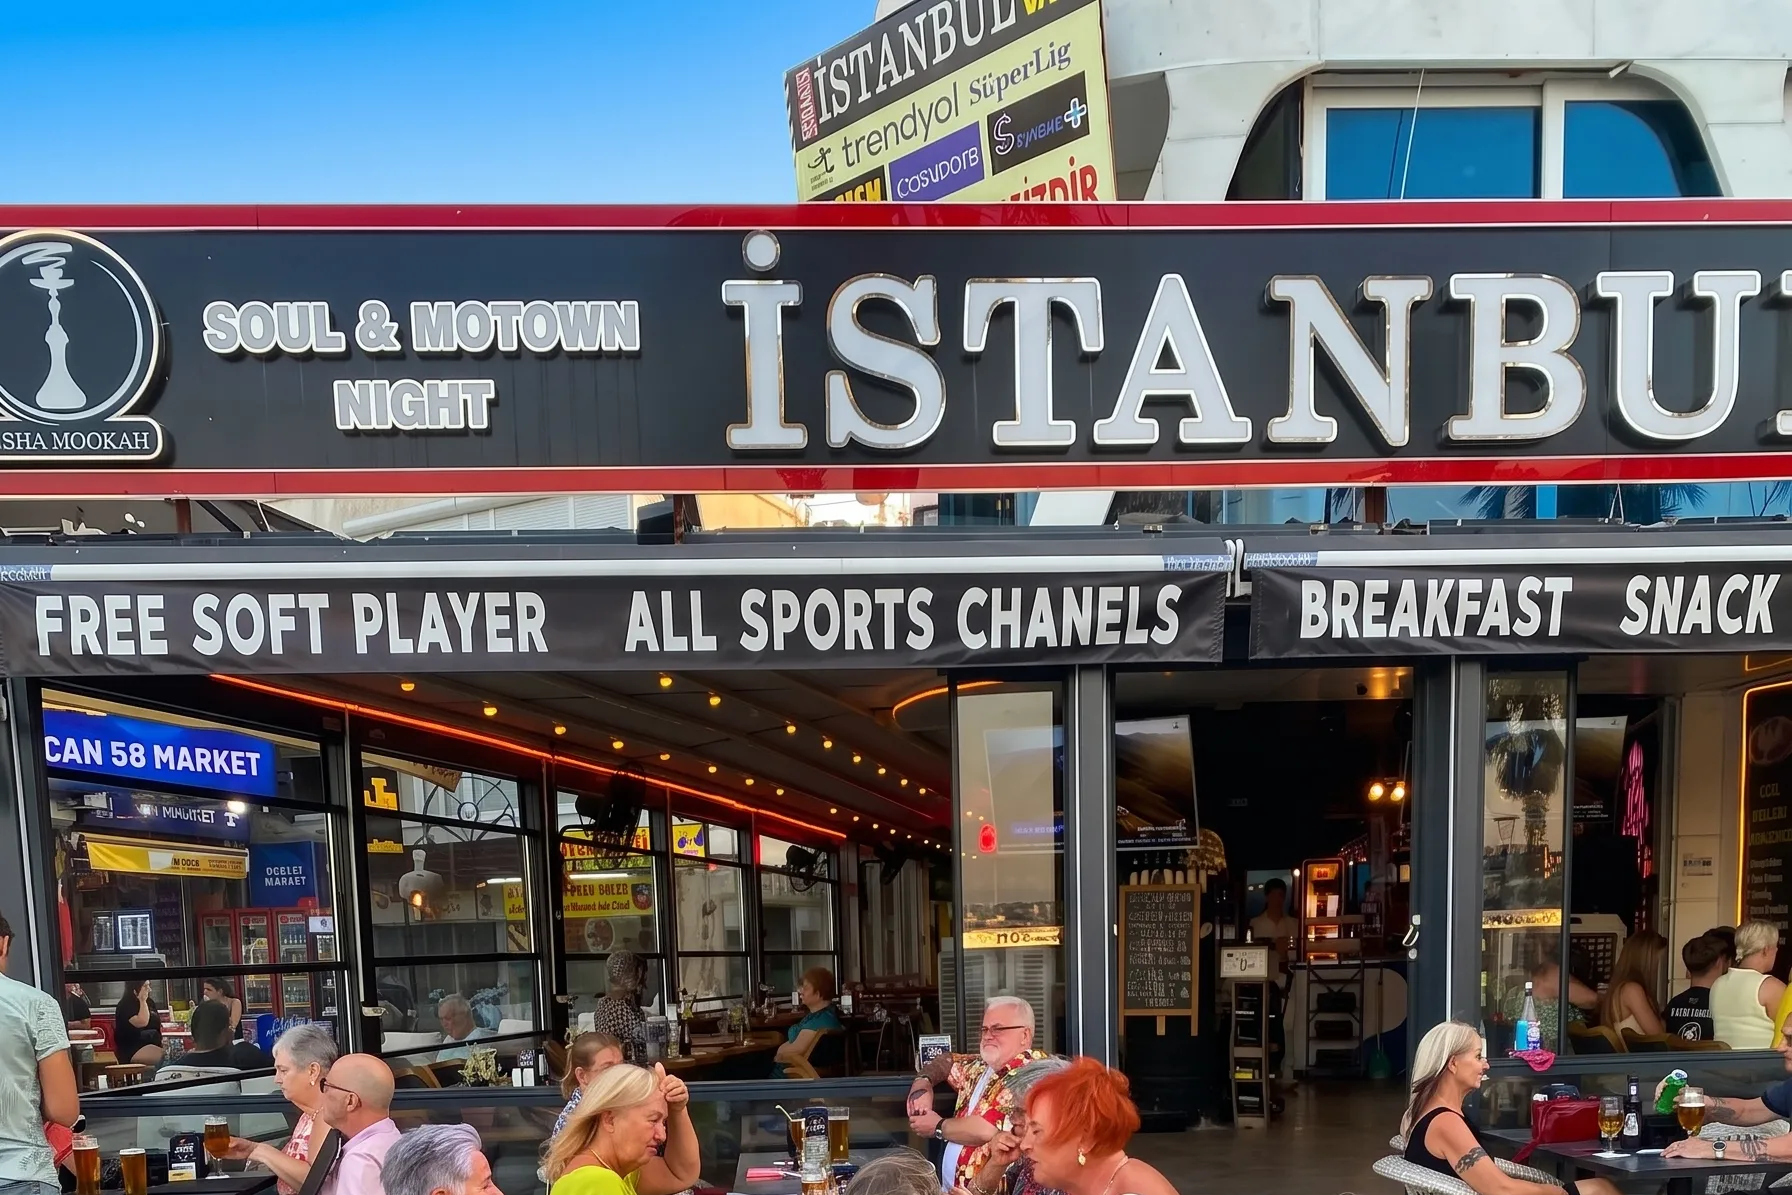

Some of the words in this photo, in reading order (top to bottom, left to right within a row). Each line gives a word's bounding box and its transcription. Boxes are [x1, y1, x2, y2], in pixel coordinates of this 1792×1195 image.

[813, 0, 1017, 124] İSTANBUL
[842, 82, 959, 168] trendyol
[202, 300, 346, 354] SOUL
[354, 300, 401, 353] &
[410, 300, 641, 353] MOTOWN
[720, 230, 1792, 451] İSTANBU
[333, 378, 496, 431] NIGHT
[0, 432, 47, 450] SHA
[52, 431, 150, 450] MOOKAH
[35, 594, 169, 656] FREE
[191, 592, 330, 656] SOFT
[353, 590, 549, 655] PLAYER
[624, 589, 717, 653] ALL
[739, 587, 935, 652] SPORTS
[956, 583, 1183, 649] CHANELS
[1300, 575, 1574, 640] BREAKFAST
[1619, 573, 1782, 637] SNACK
[44, 734, 102, 767] CAN
[110, 740, 147, 769] 58
[153, 744, 261, 777] MARKET
